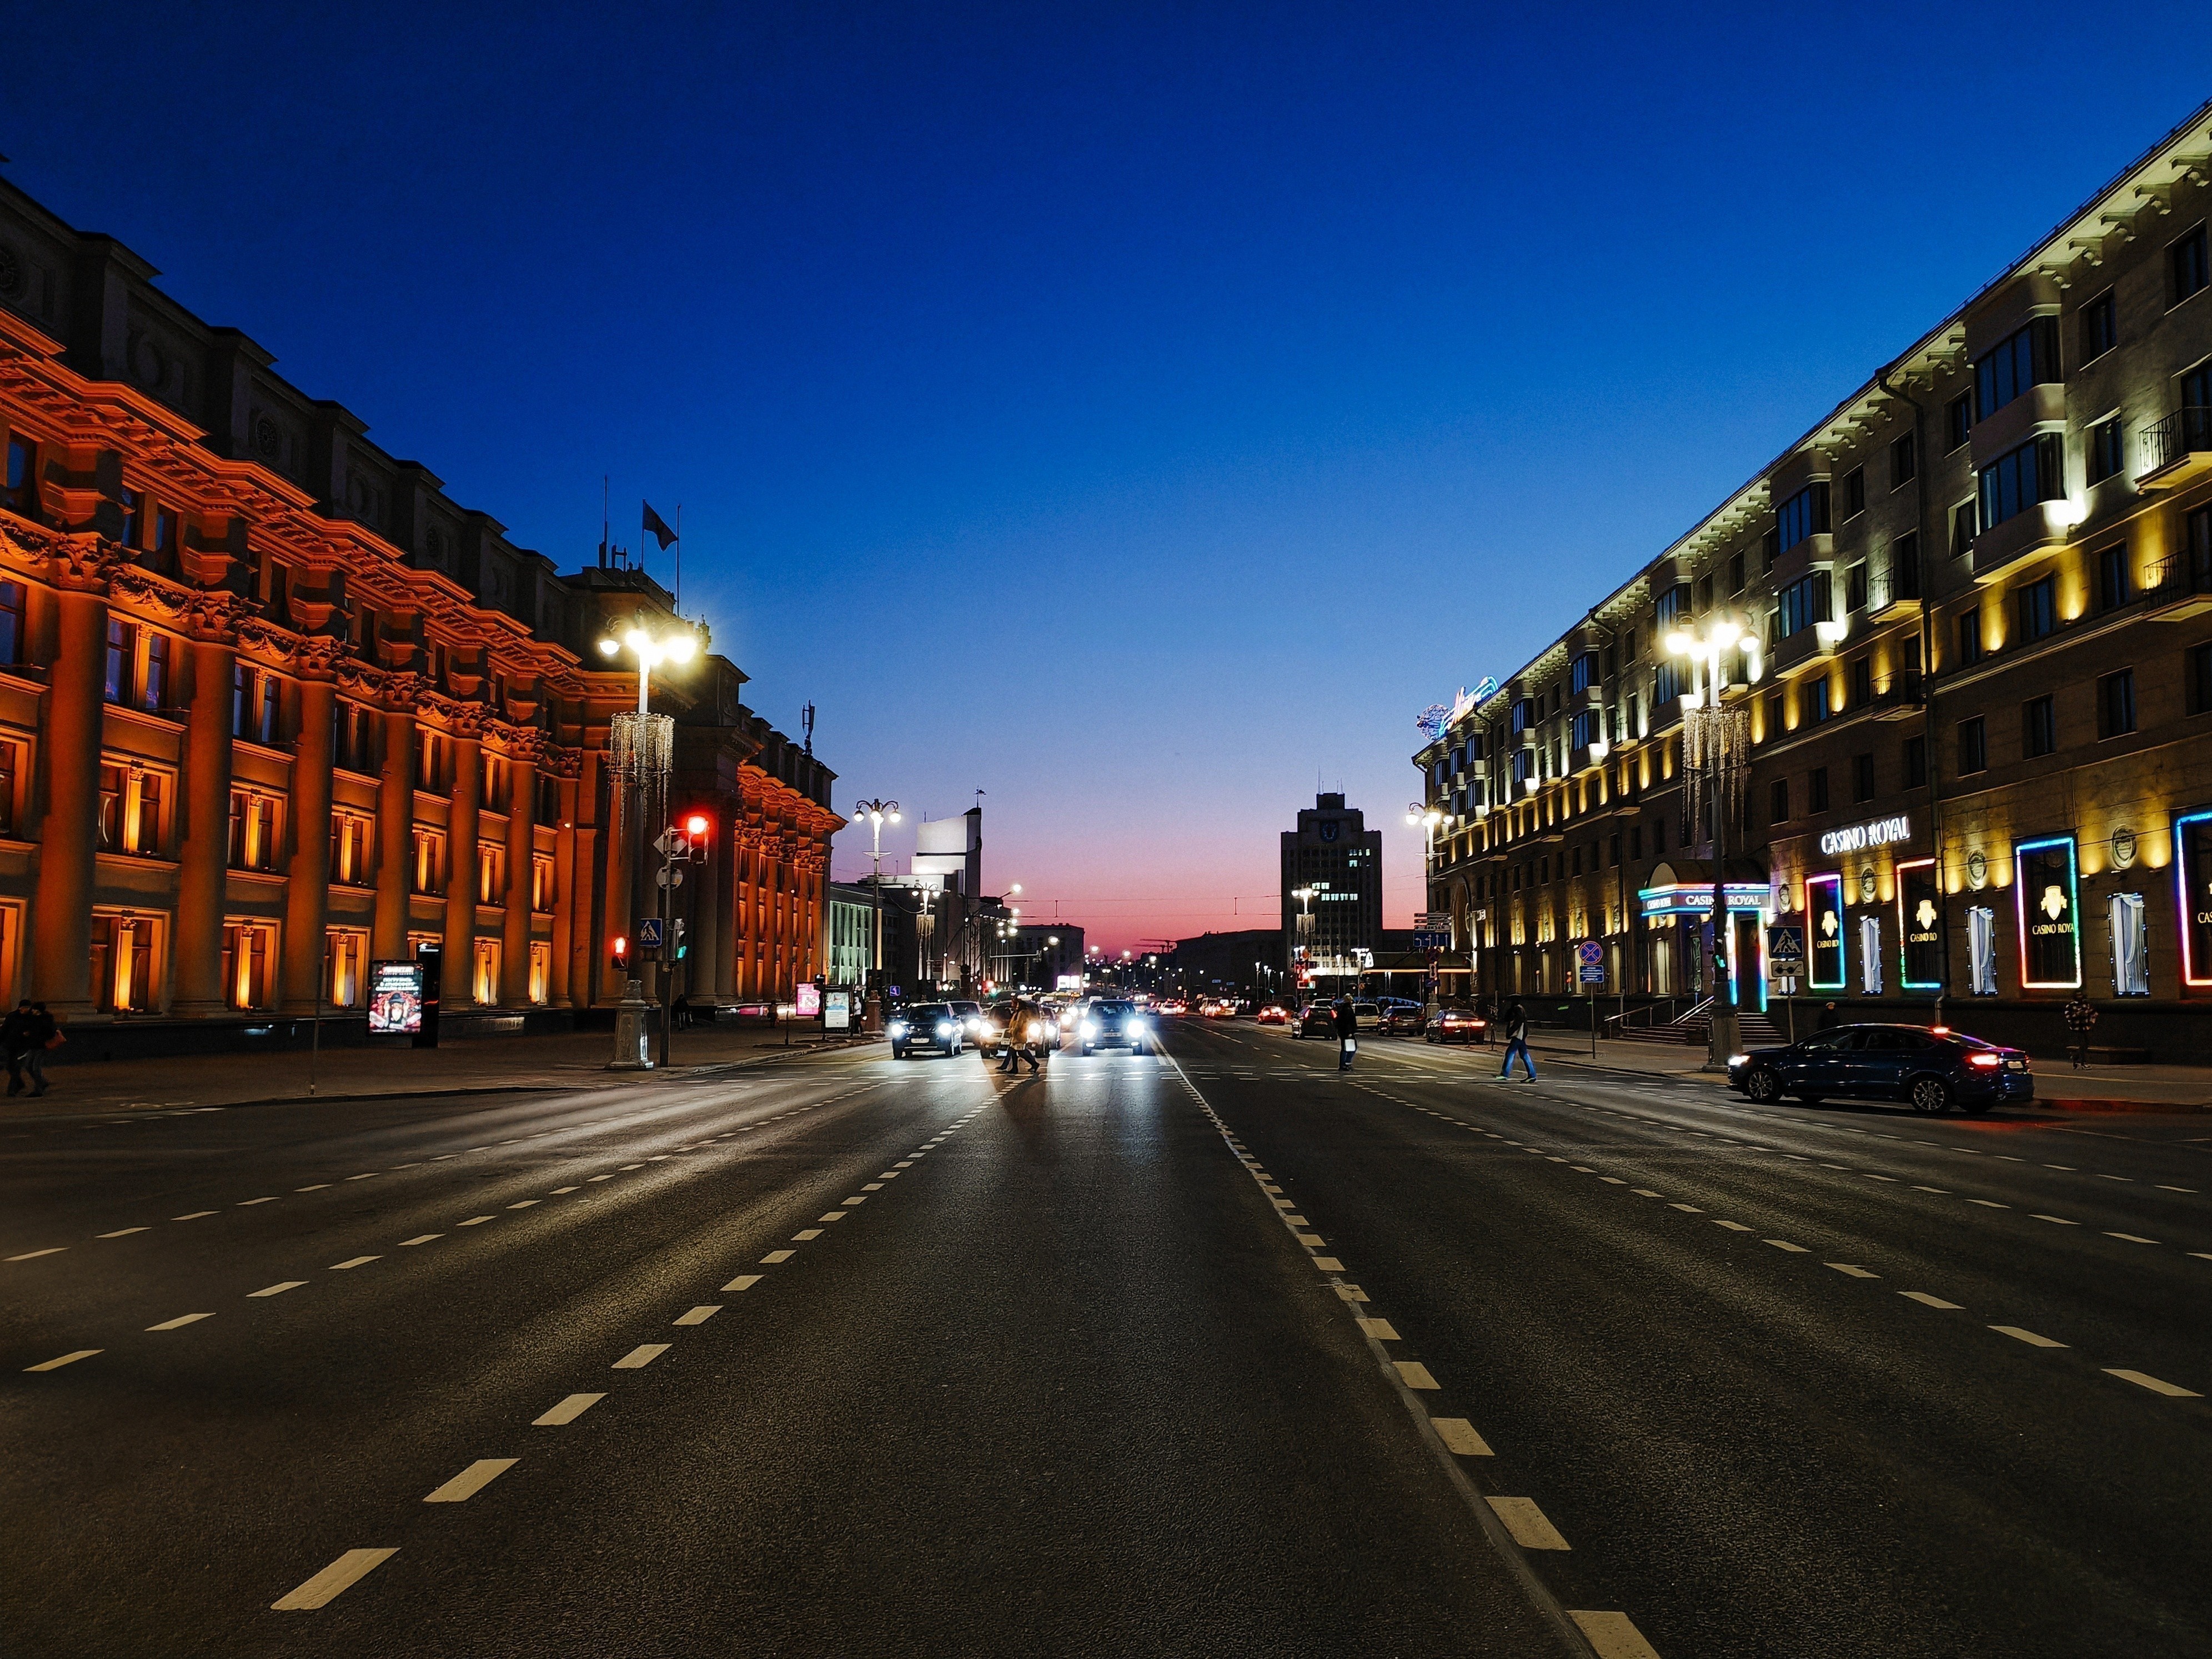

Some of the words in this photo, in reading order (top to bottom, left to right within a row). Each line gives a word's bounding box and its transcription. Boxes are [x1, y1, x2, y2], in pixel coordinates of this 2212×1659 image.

[1821, 826, 1866, 855] CASINO
[1868, 815, 1911, 846] ROYAL
[1686, 895, 1714, 906] CASIN
[1727, 895, 1762, 906] ROYAL
[2032, 924, 2056, 935] CASINO
[1910, 933, 1929, 943] CASINO
[1817, 940, 1832, 949] CASINO
